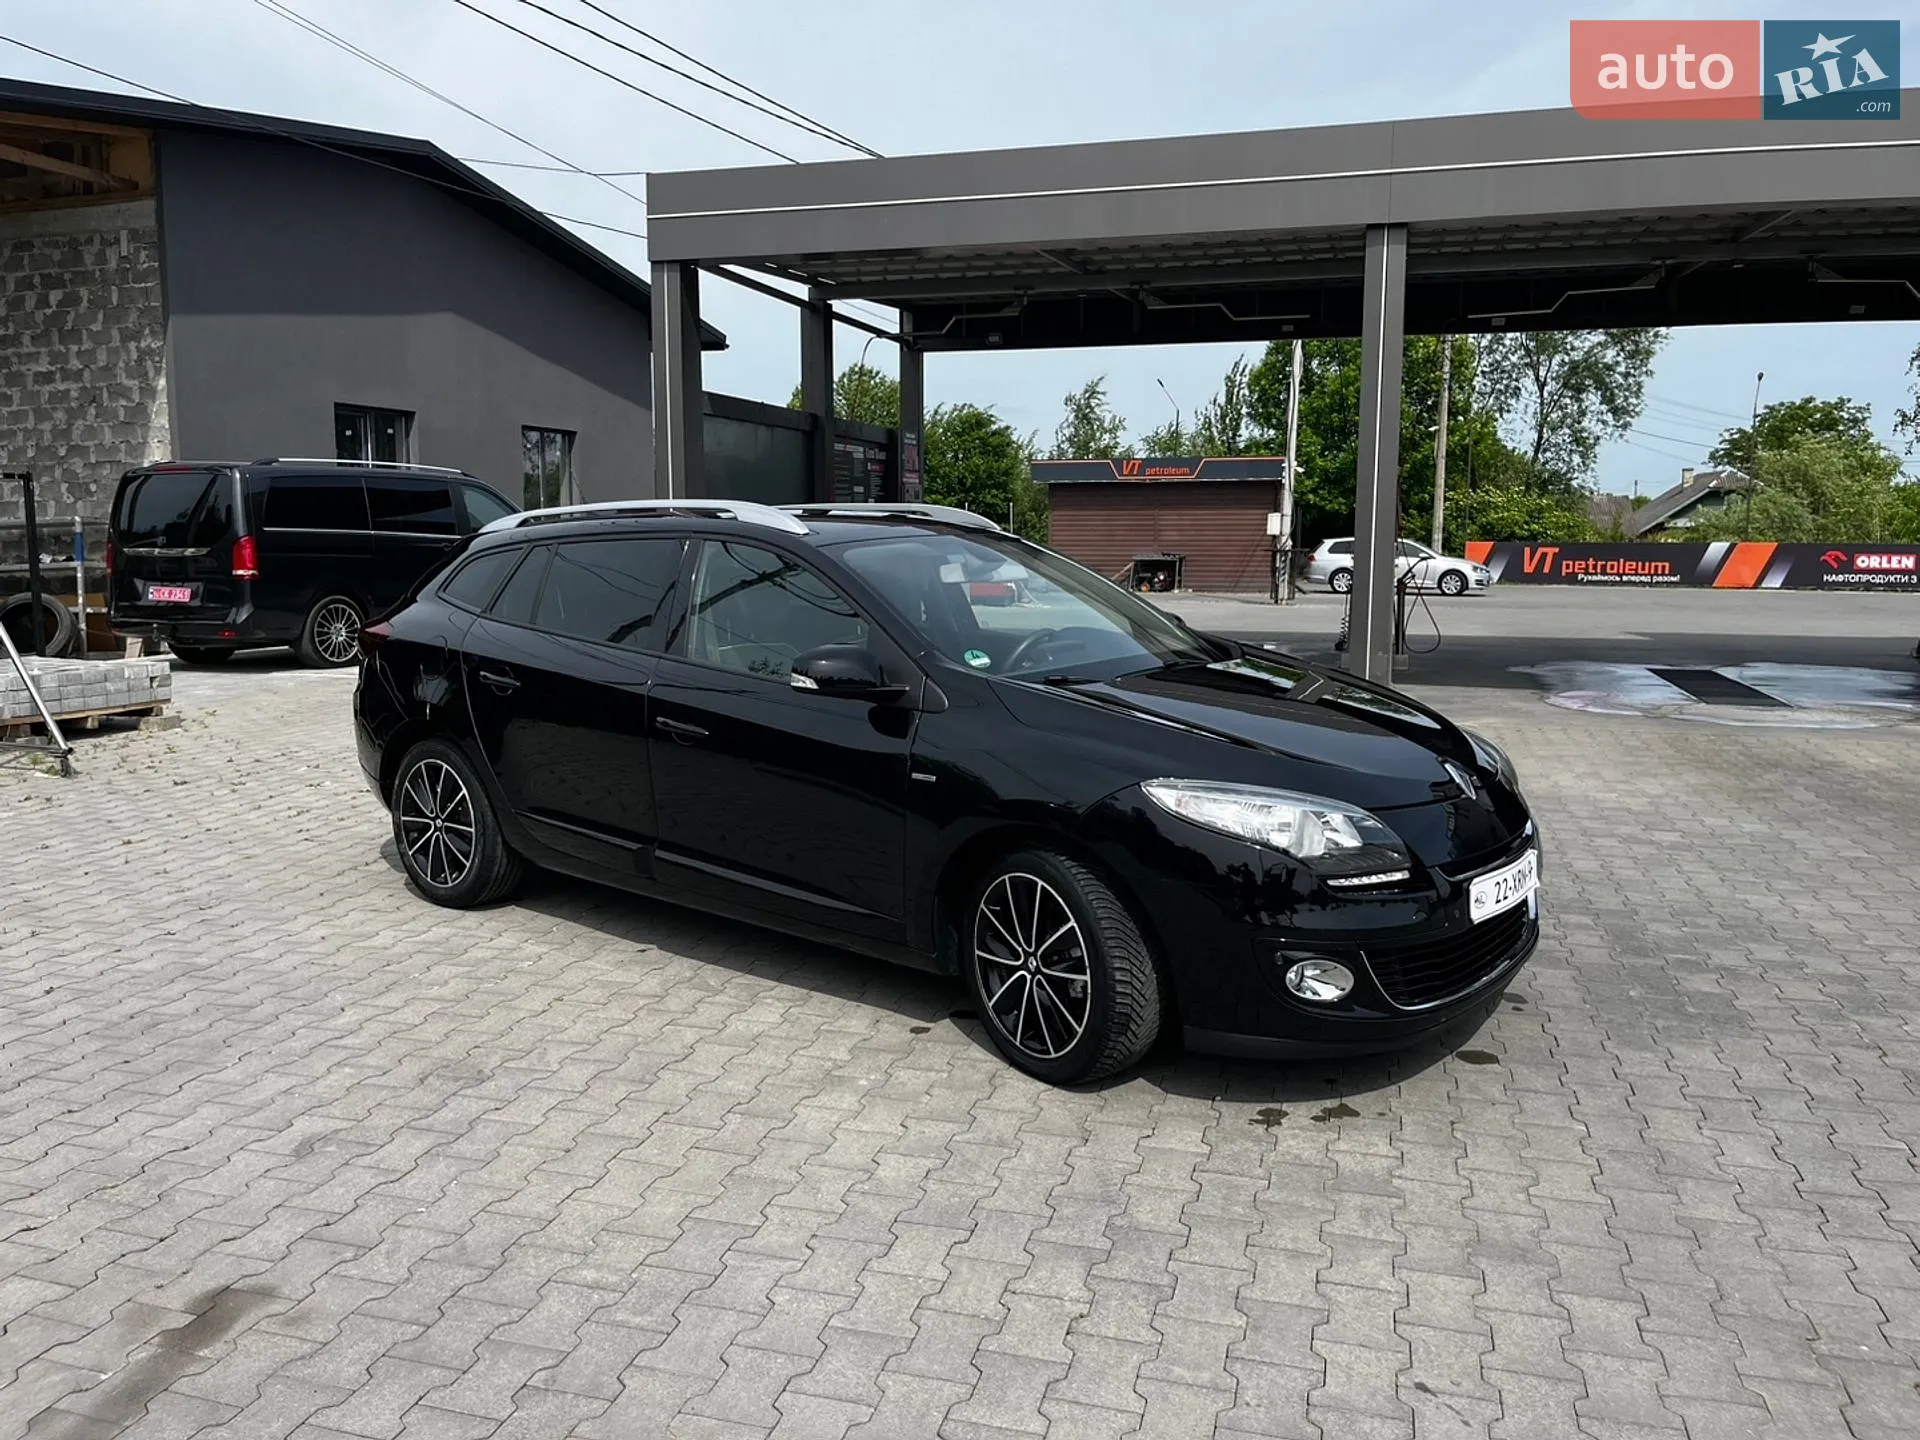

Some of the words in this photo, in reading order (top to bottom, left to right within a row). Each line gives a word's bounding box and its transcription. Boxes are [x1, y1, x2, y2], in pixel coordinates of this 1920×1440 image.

[1122, 459, 1142, 475] VT
[1145, 467, 1191, 476] petroleum
[1523, 546, 1560, 574] VT
[1561, 557, 1671, 577] petroleum
[1856, 555, 1914, 569] ORLEN
[1823, 574, 1908, 584] НАФТОПРОДУКТИ
